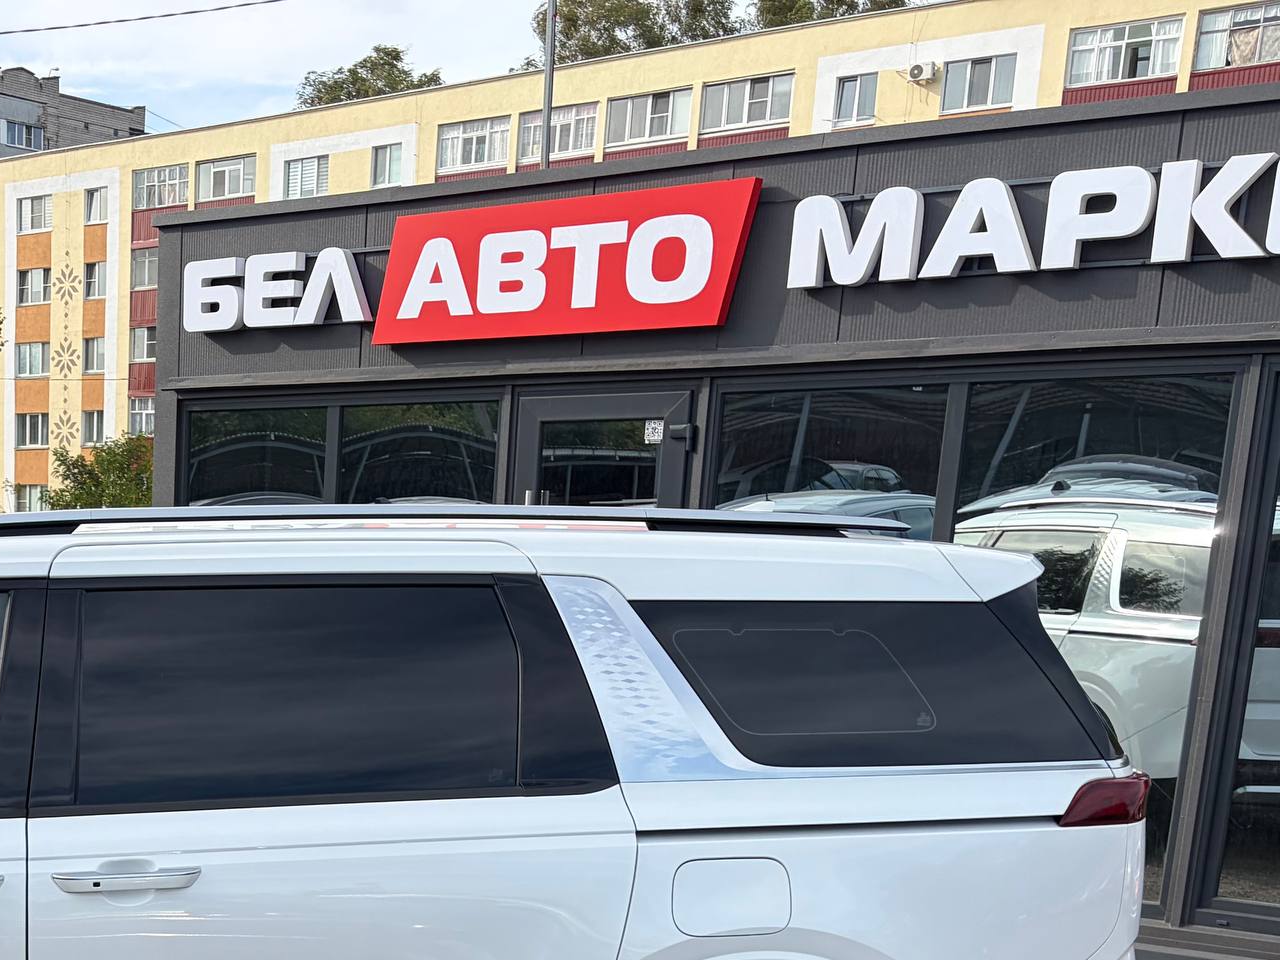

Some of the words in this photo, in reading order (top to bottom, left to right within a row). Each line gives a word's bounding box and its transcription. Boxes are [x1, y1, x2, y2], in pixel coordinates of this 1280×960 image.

[183, 246, 372, 333] БЕЛ
[395, 213, 714, 320] АВТО
[786, 151, 1280, 290] МАРК
